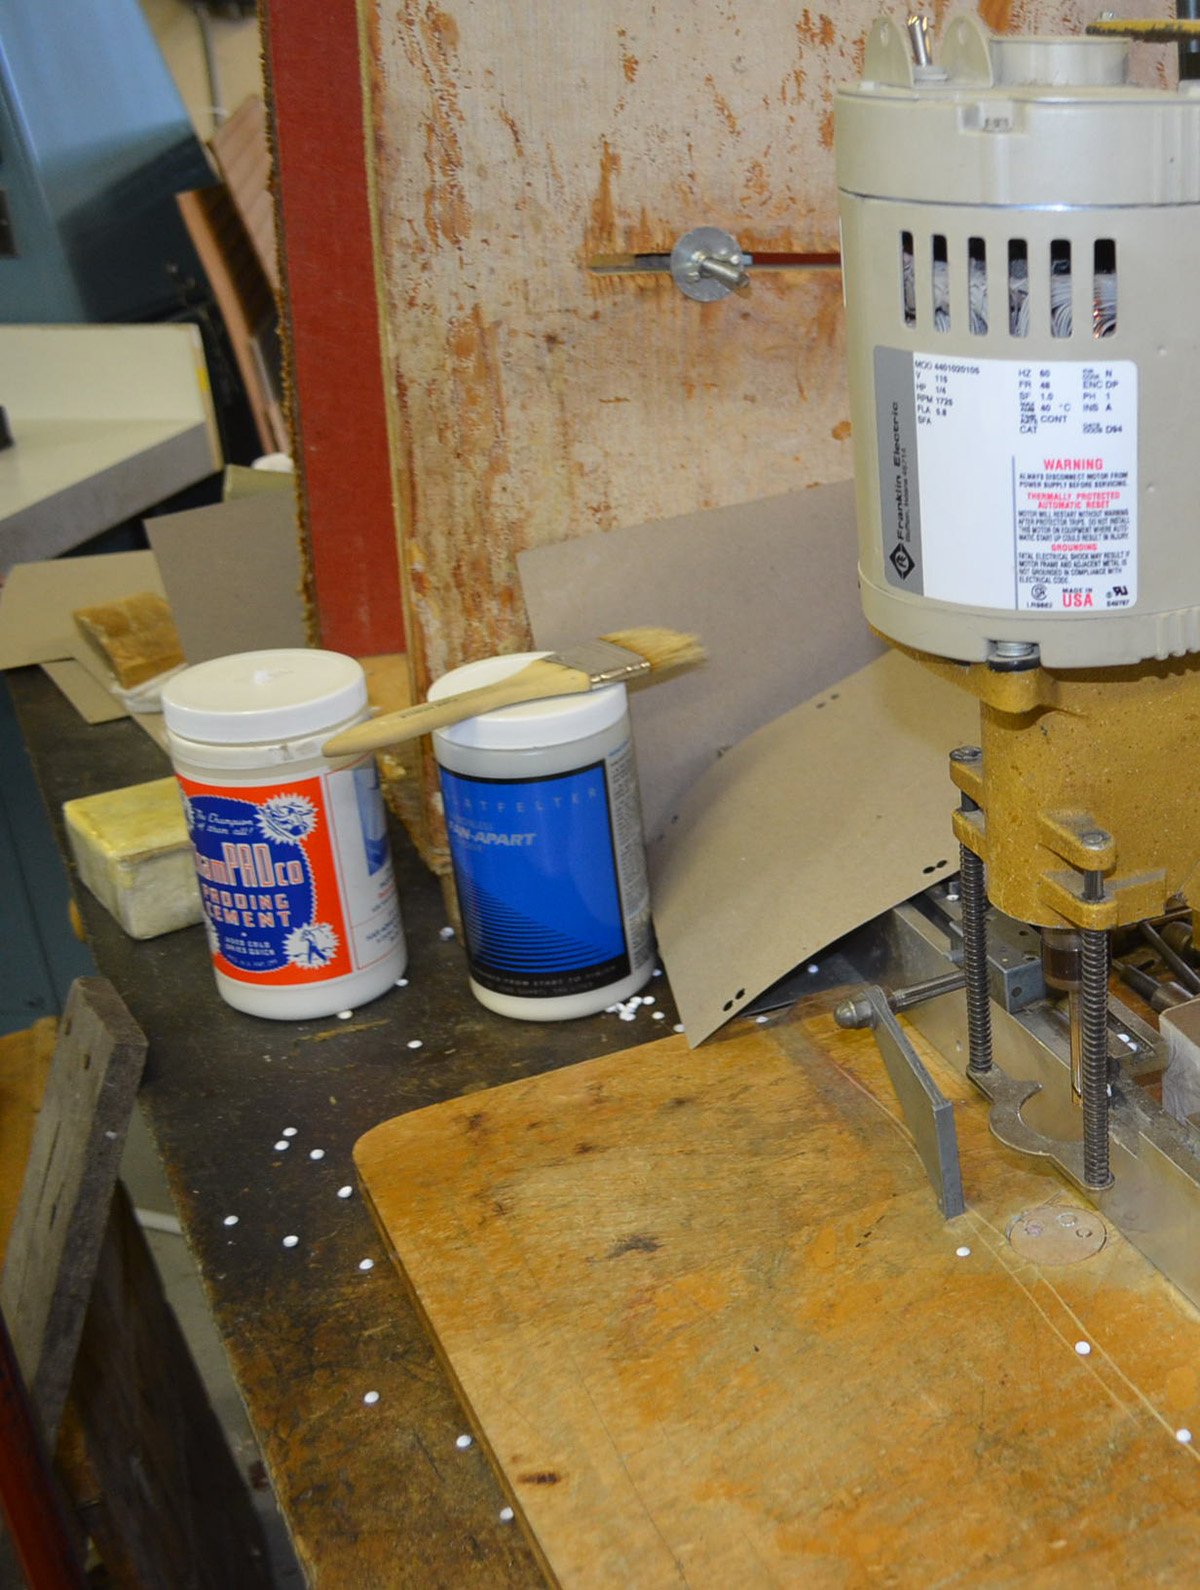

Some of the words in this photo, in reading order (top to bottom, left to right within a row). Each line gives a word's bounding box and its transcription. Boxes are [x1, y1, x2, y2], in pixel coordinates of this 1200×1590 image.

[1018, 369, 1031, 378] HZ
[1040, 369, 1050, 378] 60
[1105, 369, 1113, 378] N
[916, 382, 926, 391] HP
[1018, 380, 1031, 389] FR
[1082, 380, 1102, 389] ENC
[1105, 380, 1119, 389] DP
[916, 393, 933, 403] RPM
[1019, 391, 1030, 400] SF
[1082, 391, 1096, 400] PH
[917, 404, 931, 414] FLA
[1040, 403, 1051, 412] 40
[1082, 403, 1099, 412] INS
[1040, 414, 1068, 423] CONT
[1019, 423, 1037, 434] CAT
[1043, 458, 1104, 471] WARNING
[1046, 472, 1085, 480] DISCONNECT
[1027, 492, 1072, 500] THERMALLY
[1076, 491, 1121, 499] PROTECTED
[895, 477, 904, 540] Franklin
[1038, 501, 1081, 509] AUTOMATIC
[1086, 501, 1110, 509] RESET
[1051, 543, 1098, 551] GROUNDING
[1103, 551, 1124, 559] RESULT
[1062, 592, 1093, 608] USA
[208, 812, 254, 828] Champion
[205, 901, 291, 928] CEMENT
[248, 946, 276, 957] QUICK
